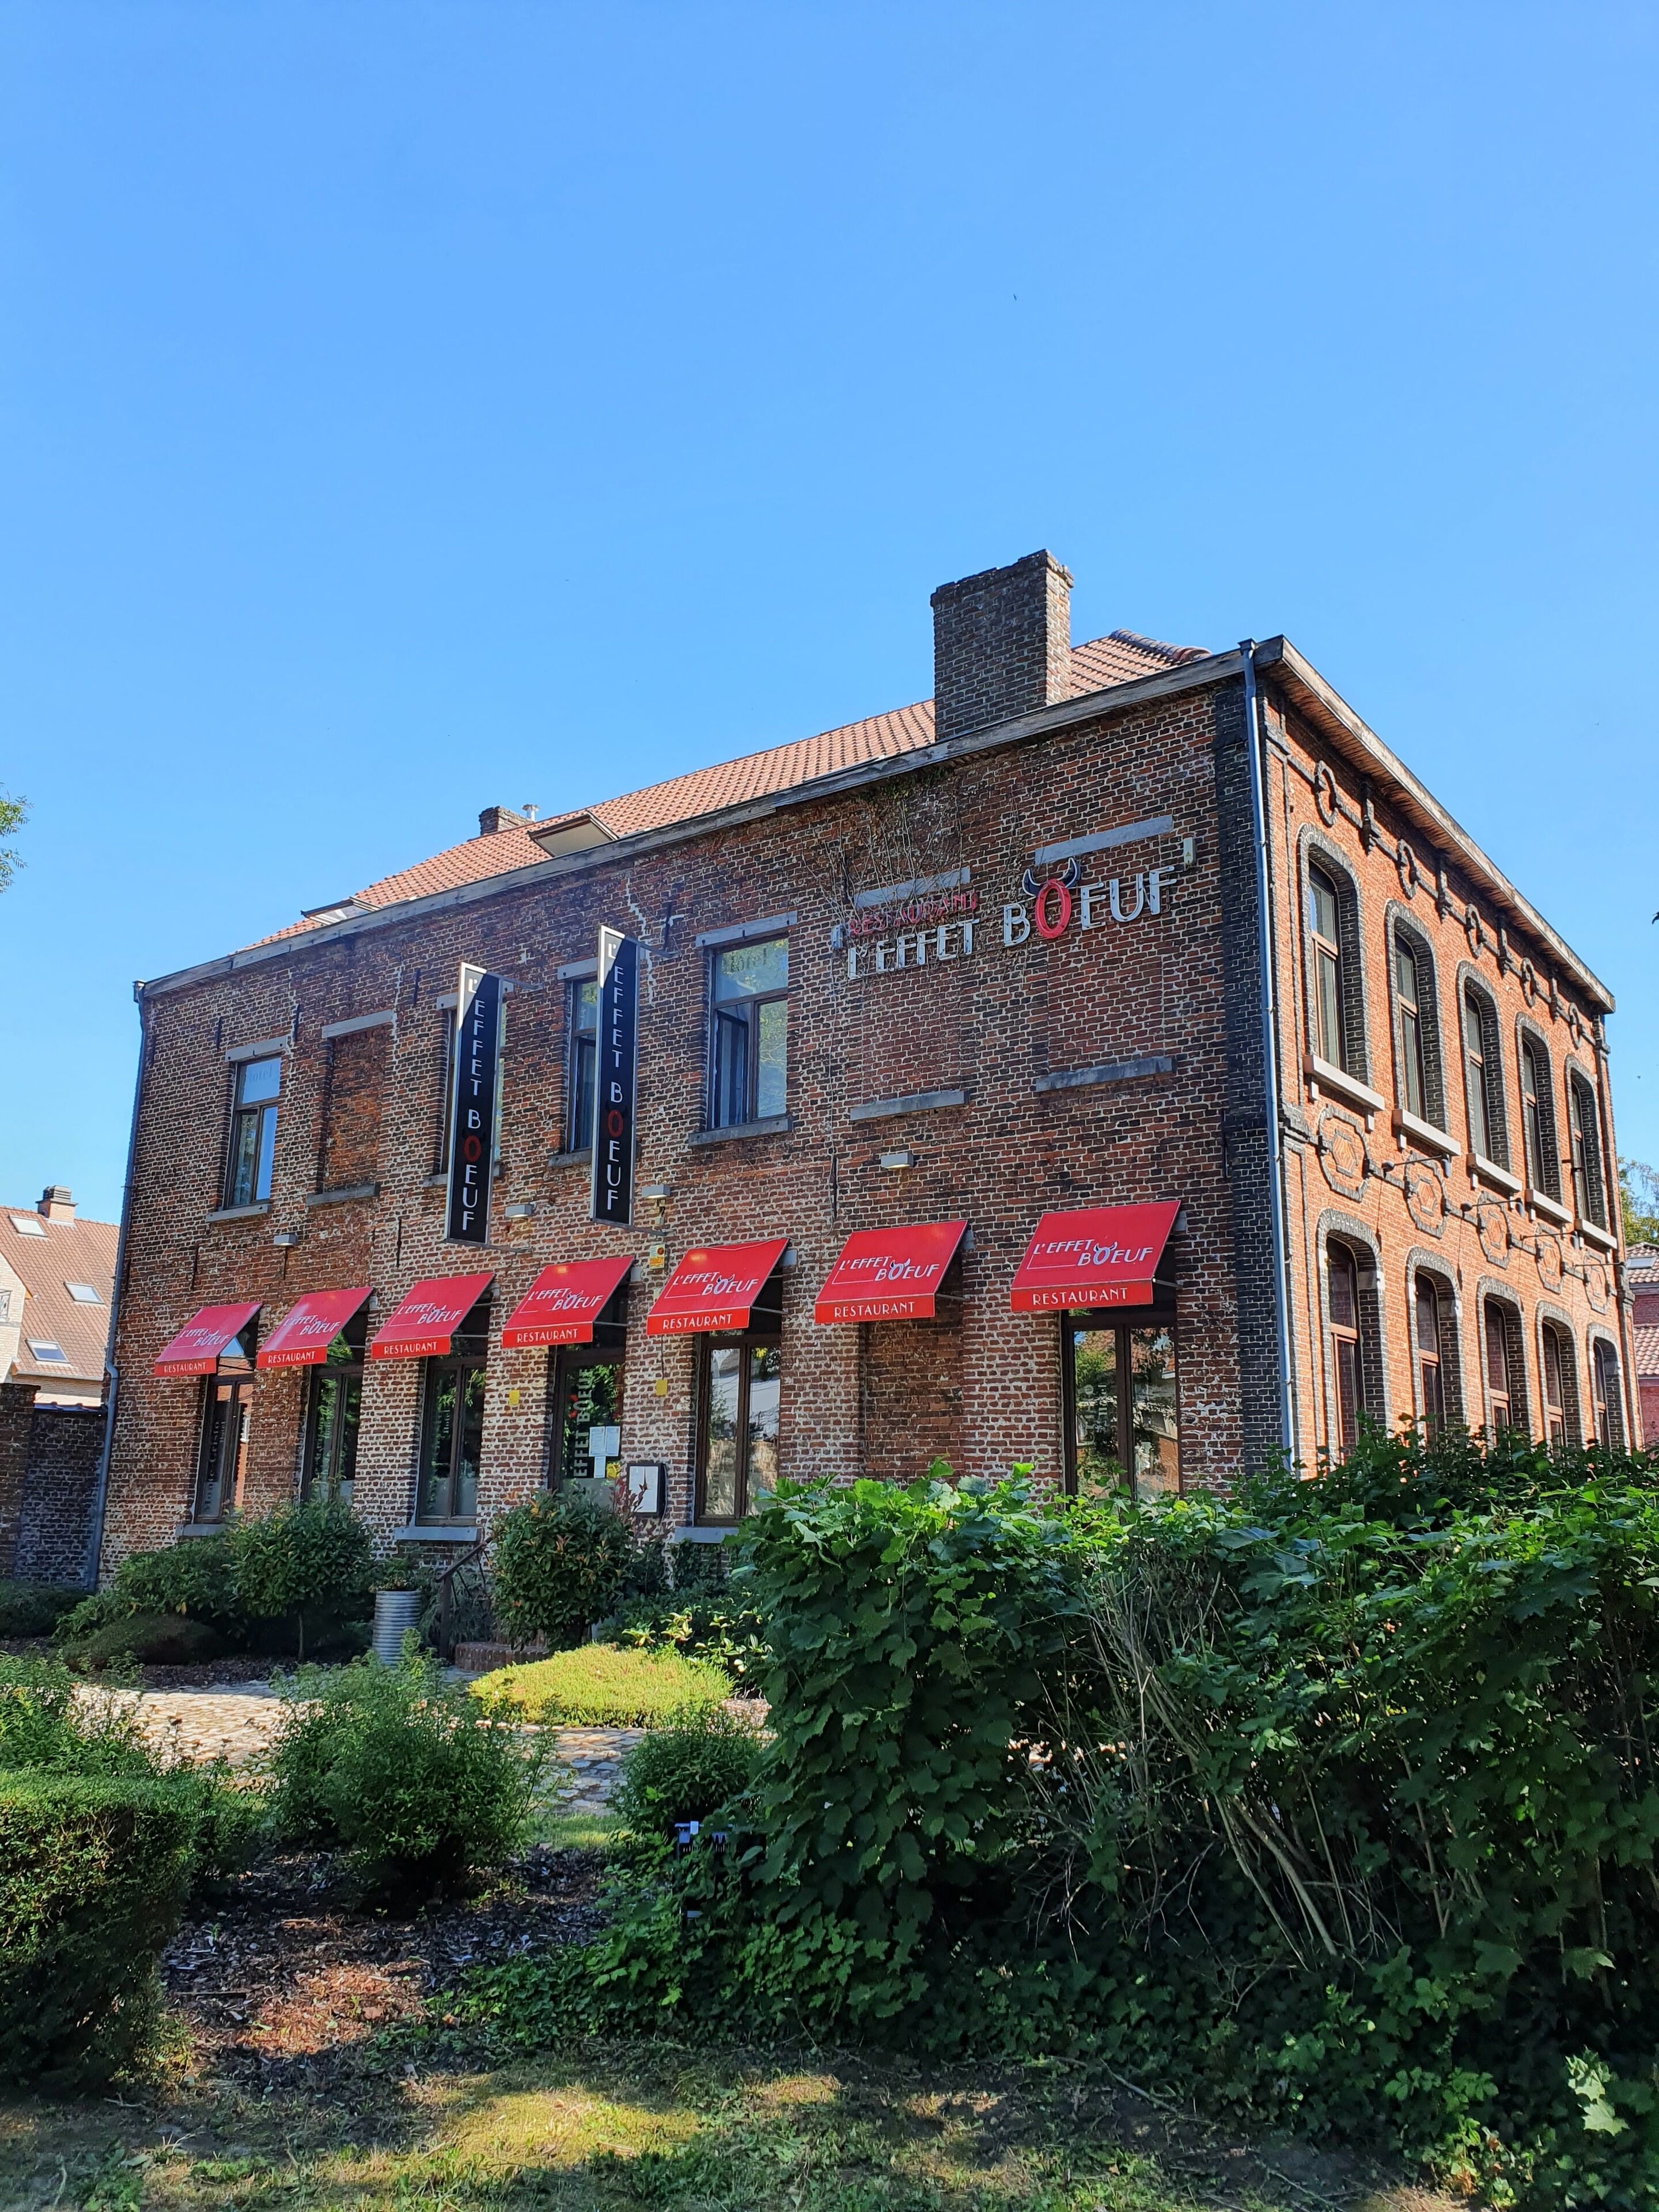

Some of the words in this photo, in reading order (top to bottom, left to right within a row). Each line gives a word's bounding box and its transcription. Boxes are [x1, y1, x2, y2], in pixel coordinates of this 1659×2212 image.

[1003, 866, 1177, 946] BOEUF
[608, 943, 624, 1068] L'EFFET
[468, 978, 486, 1096] L'EFFET
[607, 1081, 624, 1210] BOEUF
[463, 1109, 482, 1231] BOEUF
[1033, 1239, 1095, 1255] L'EFFET
[839, 1256, 893, 1271] L'EFFET
[1077, 1247, 1154, 1267] BOEUF
[672, 1271, 721, 1286] L'EFFET
[874, 1263, 940, 1282] BOEUF
[527, 1287, 571, 1301] L'EFFET
[701, 1278, 759, 1296] BOEUF
[551, 1294, 604, 1311] BOEUF
[1032, 1287, 1128, 1306] RESTAURANT
[397, 1302, 436, 1315] L'EFFET
[416, 1309, 464, 1324] BOEUF
[835, 1301, 915, 1318] RESTAURANT
[283, 1315, 319, 1326] L'EFFET
[299, 1321, 342, 1335] BOEUF
[663, 1314, 733, 1330] RESTAURANT
[517, 1328, 578, 1343] RESTAURANT
[384, 1341, 438, 1355] RESTAURANT
[268, 1351, 316, 1364] RESTAURANT
[164, 1361, 207, 1374] RESTAURANT
[573, 1431, 589, 1477] EFFET
